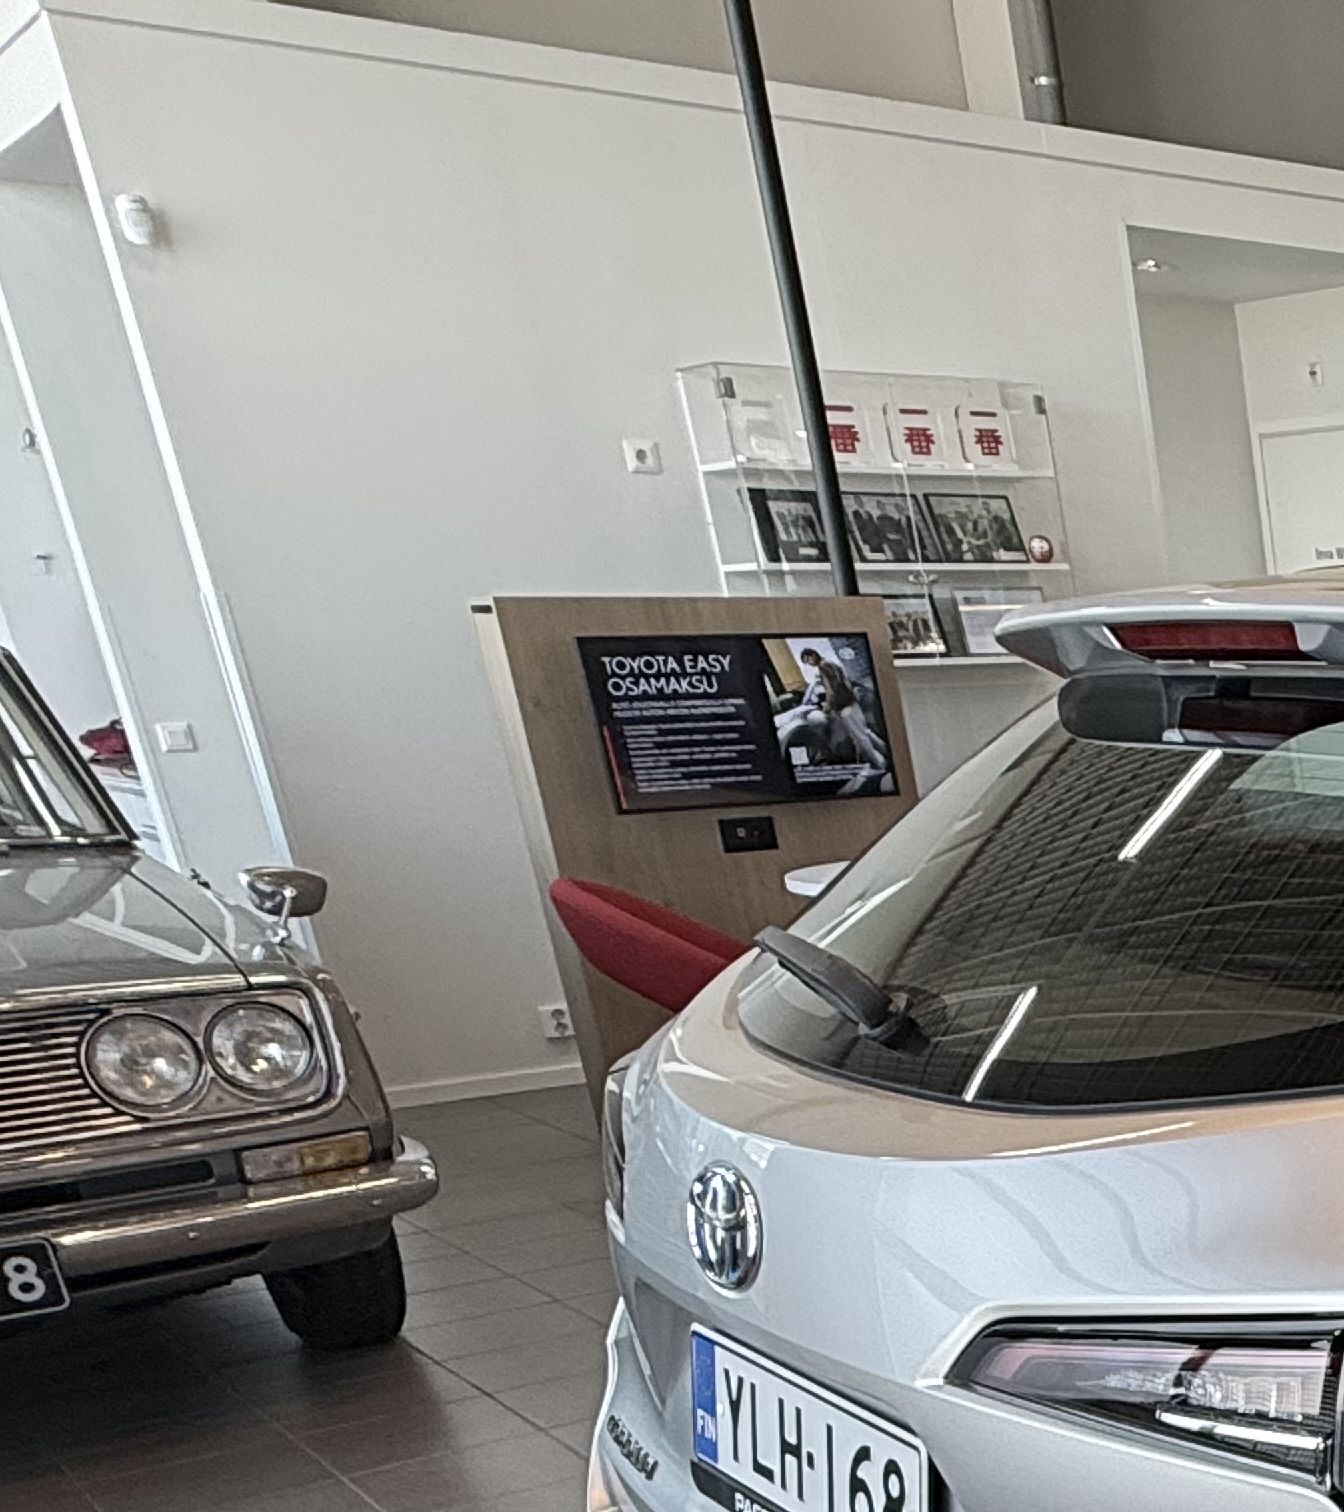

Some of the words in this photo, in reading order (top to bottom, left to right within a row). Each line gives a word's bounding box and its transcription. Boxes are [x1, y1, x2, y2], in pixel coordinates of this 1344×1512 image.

[601, 655, 682, 675] TOYOTA
[683, 654, 732, 673] EASY
[607, 675, 719, 696] OSAMAKSU
[2, 1255, 46, 1303] 8
[696, 1408, 717, 1443] FIN
